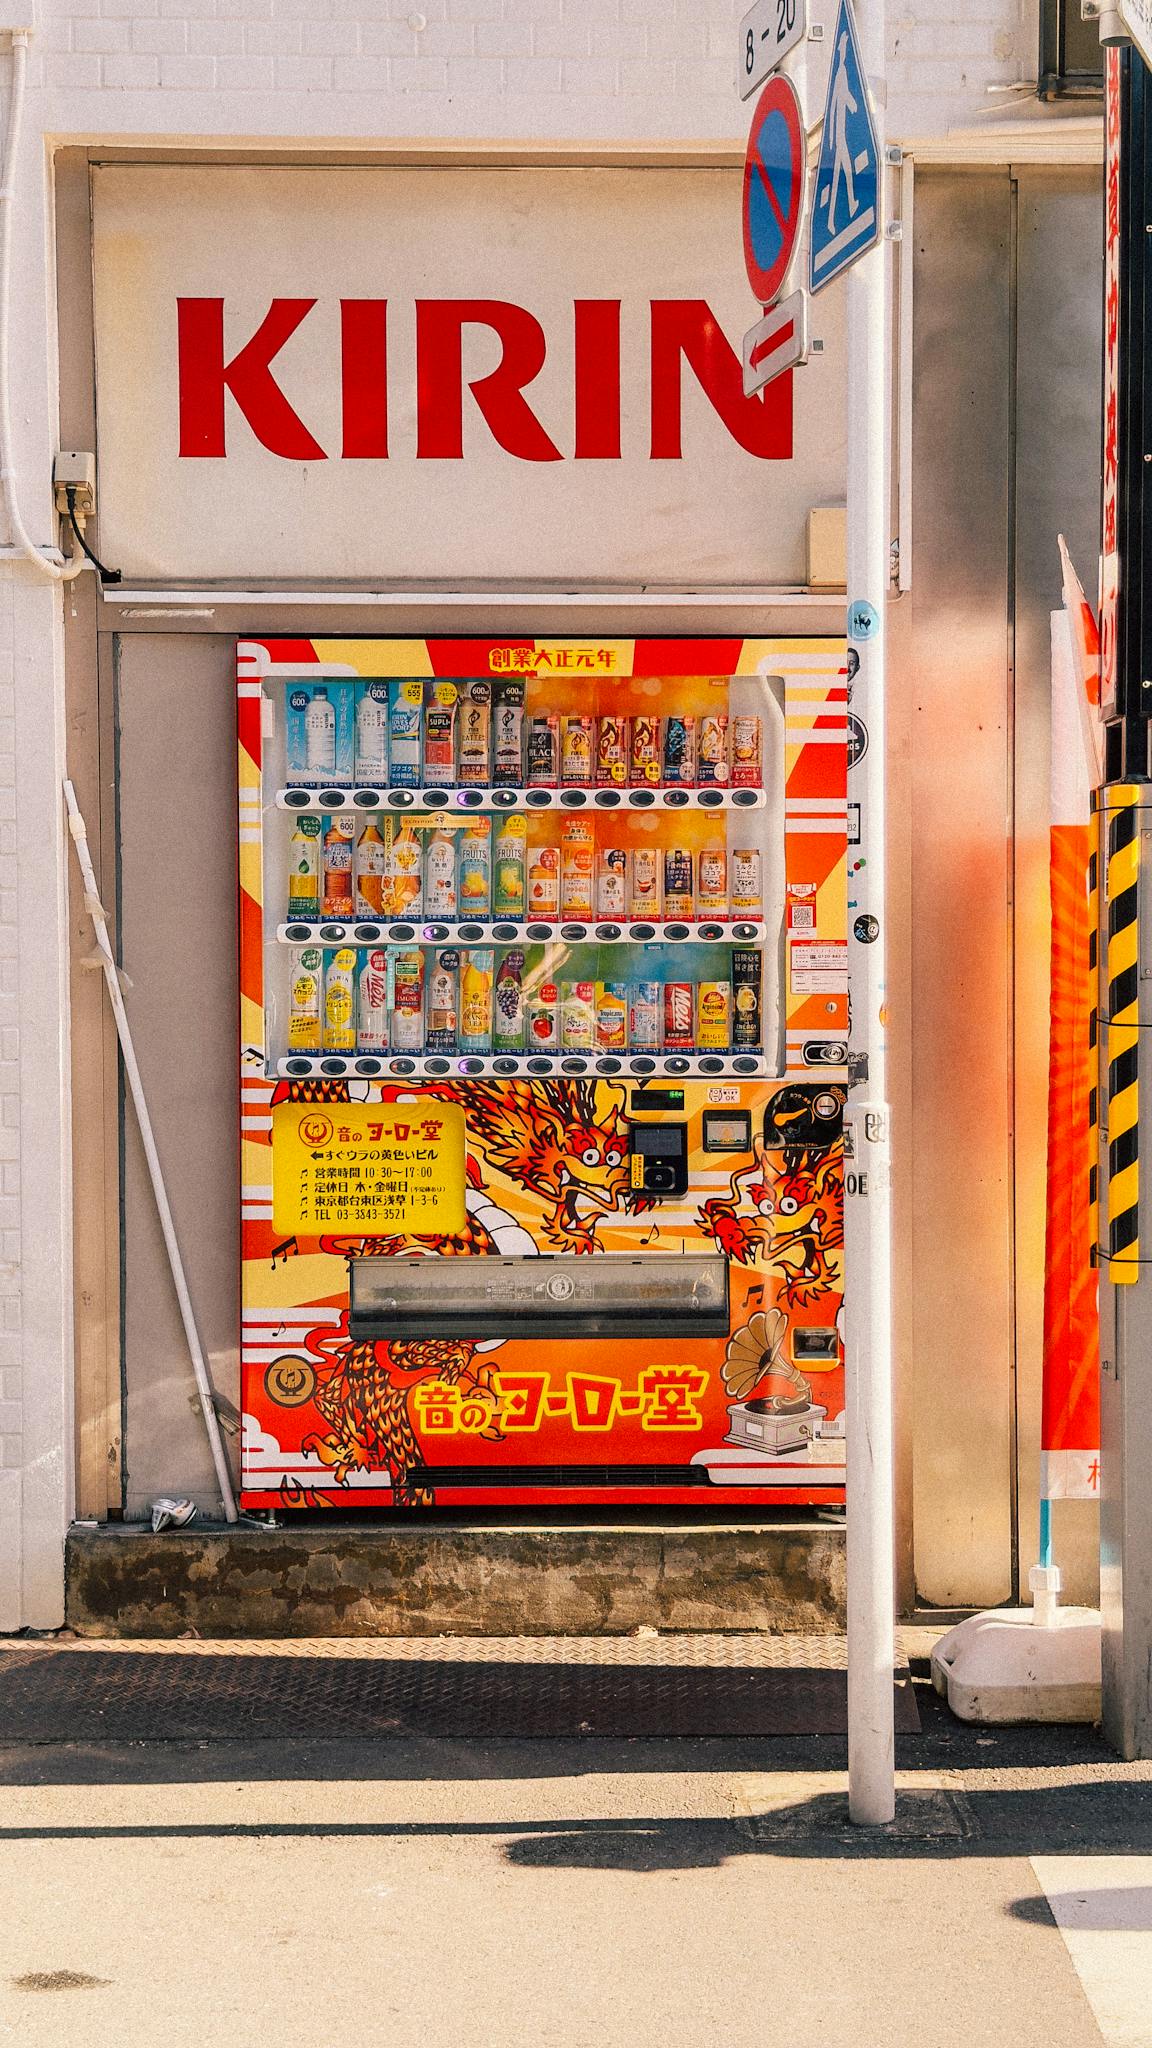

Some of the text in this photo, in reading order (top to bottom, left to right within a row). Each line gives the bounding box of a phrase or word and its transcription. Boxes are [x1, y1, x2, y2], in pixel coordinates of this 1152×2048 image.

[177, 297, 794, 461] KIRIN
[491, 648, 616, 668] 創業大正元年
[371, 689, 387, 698] 600
[292, 698, 306, 706] 600
[340, 822, 354, 831] 600
[463, 850, 487, 859] FRUITS
[497, 850, 522, 859] FRUITS
[675, 987, 691, 1030] Mets
[325, 1149, 439, 1161] すぐウラの黄色いビル
[315, 1167, 360, 1179] 営業時間
[314, 1181, 348, 1193] 定休日
[844, 1174, 869, 1196] OE
[315, 1194, 438, 1207] 東京都台東区浅草 1-3-6
[315, 1209, 405, 1220] TEL 03-3843-3521
[417, 1367, 708, 1431] 音のヨーロー堂
